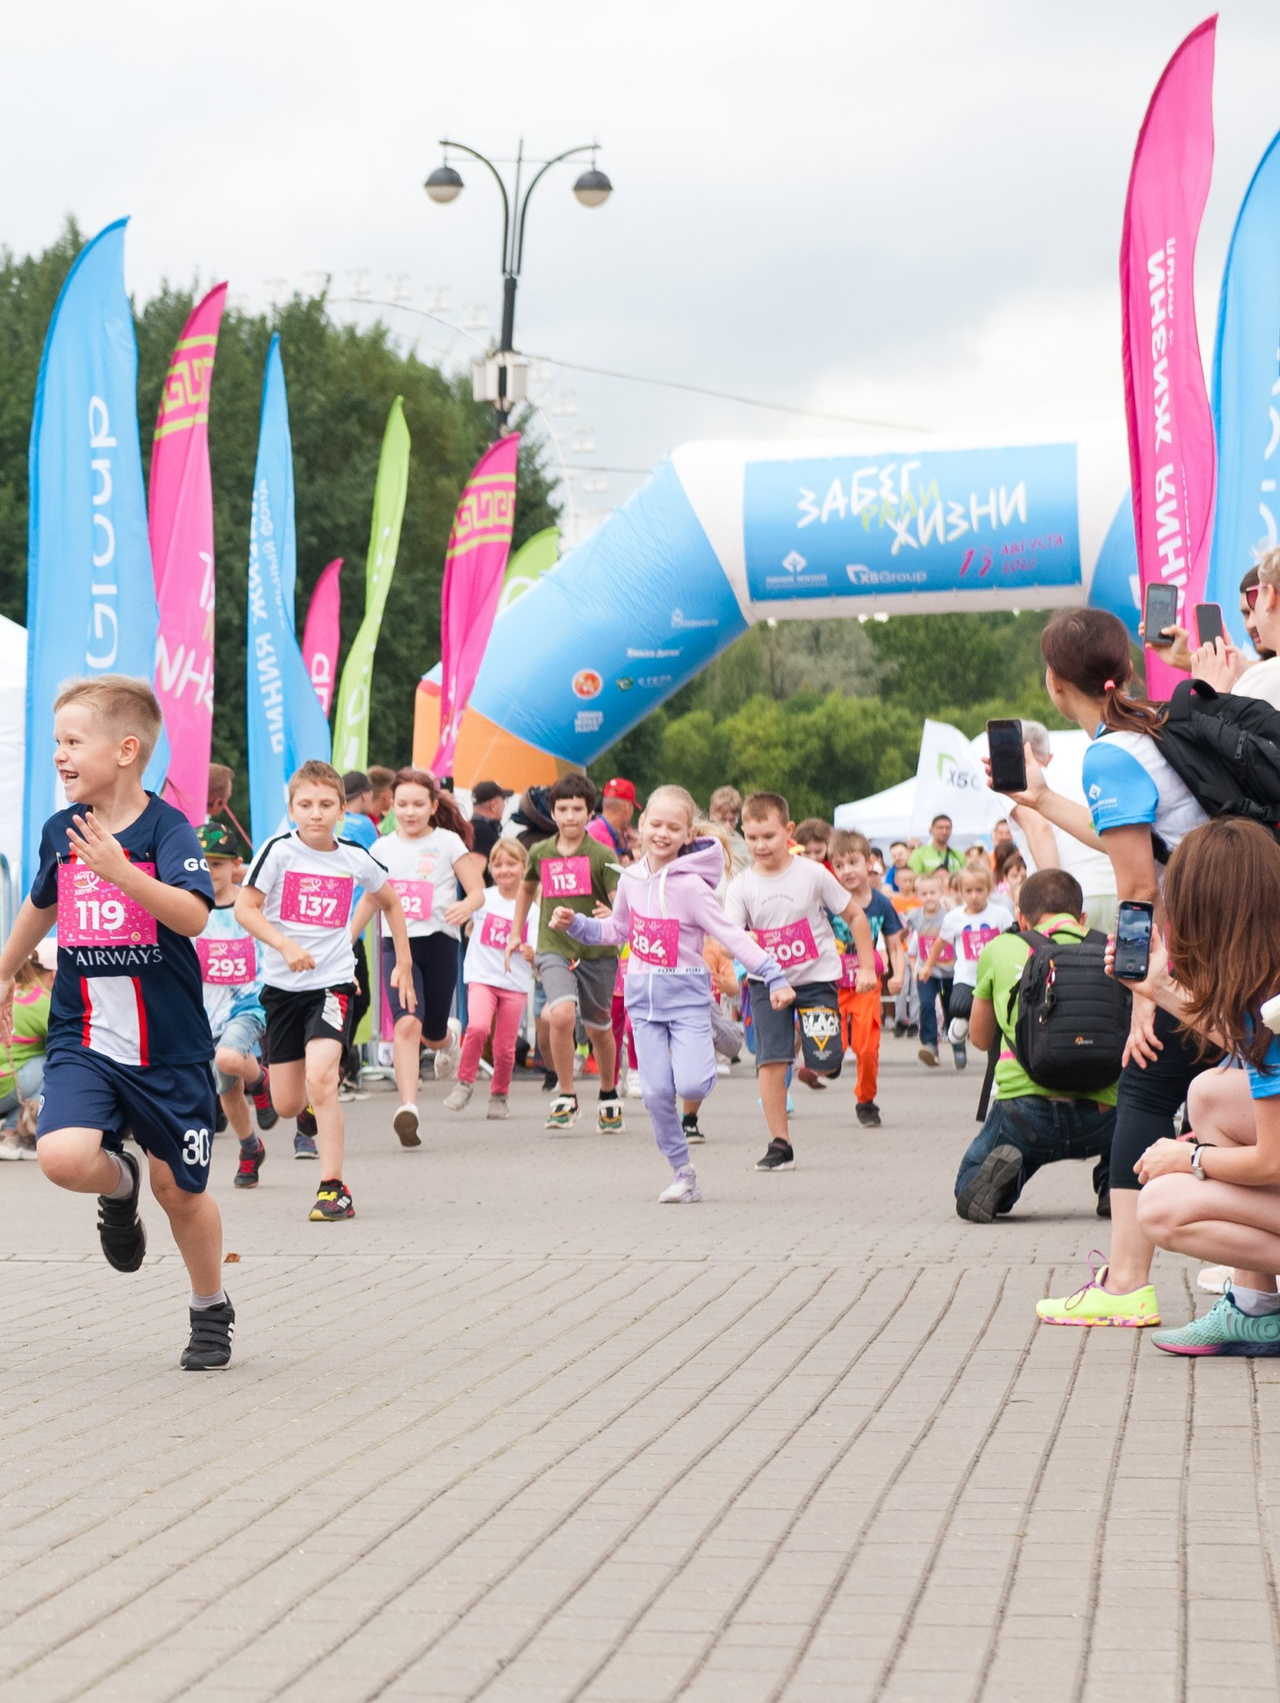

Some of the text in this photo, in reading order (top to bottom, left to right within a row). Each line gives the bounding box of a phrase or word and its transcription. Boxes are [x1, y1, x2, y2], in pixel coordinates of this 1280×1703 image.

[1147, 249, 1172, 455] ЖИЗНИ
[796, 460, 921, 529] ЗАБЕГ
[887, 480, 1027, 556] ЖИЗНИ
[551, 873, 577, 890] 113
[76, 900, 125, 930] 119
[298, 894, 338, 918] 137
[76, 948, 163, 967] AIRWAYS
[632, 930, 666, 958] 284
[207, 958, 247, 977] 293
[182, 1128, 210, 1167] 30
